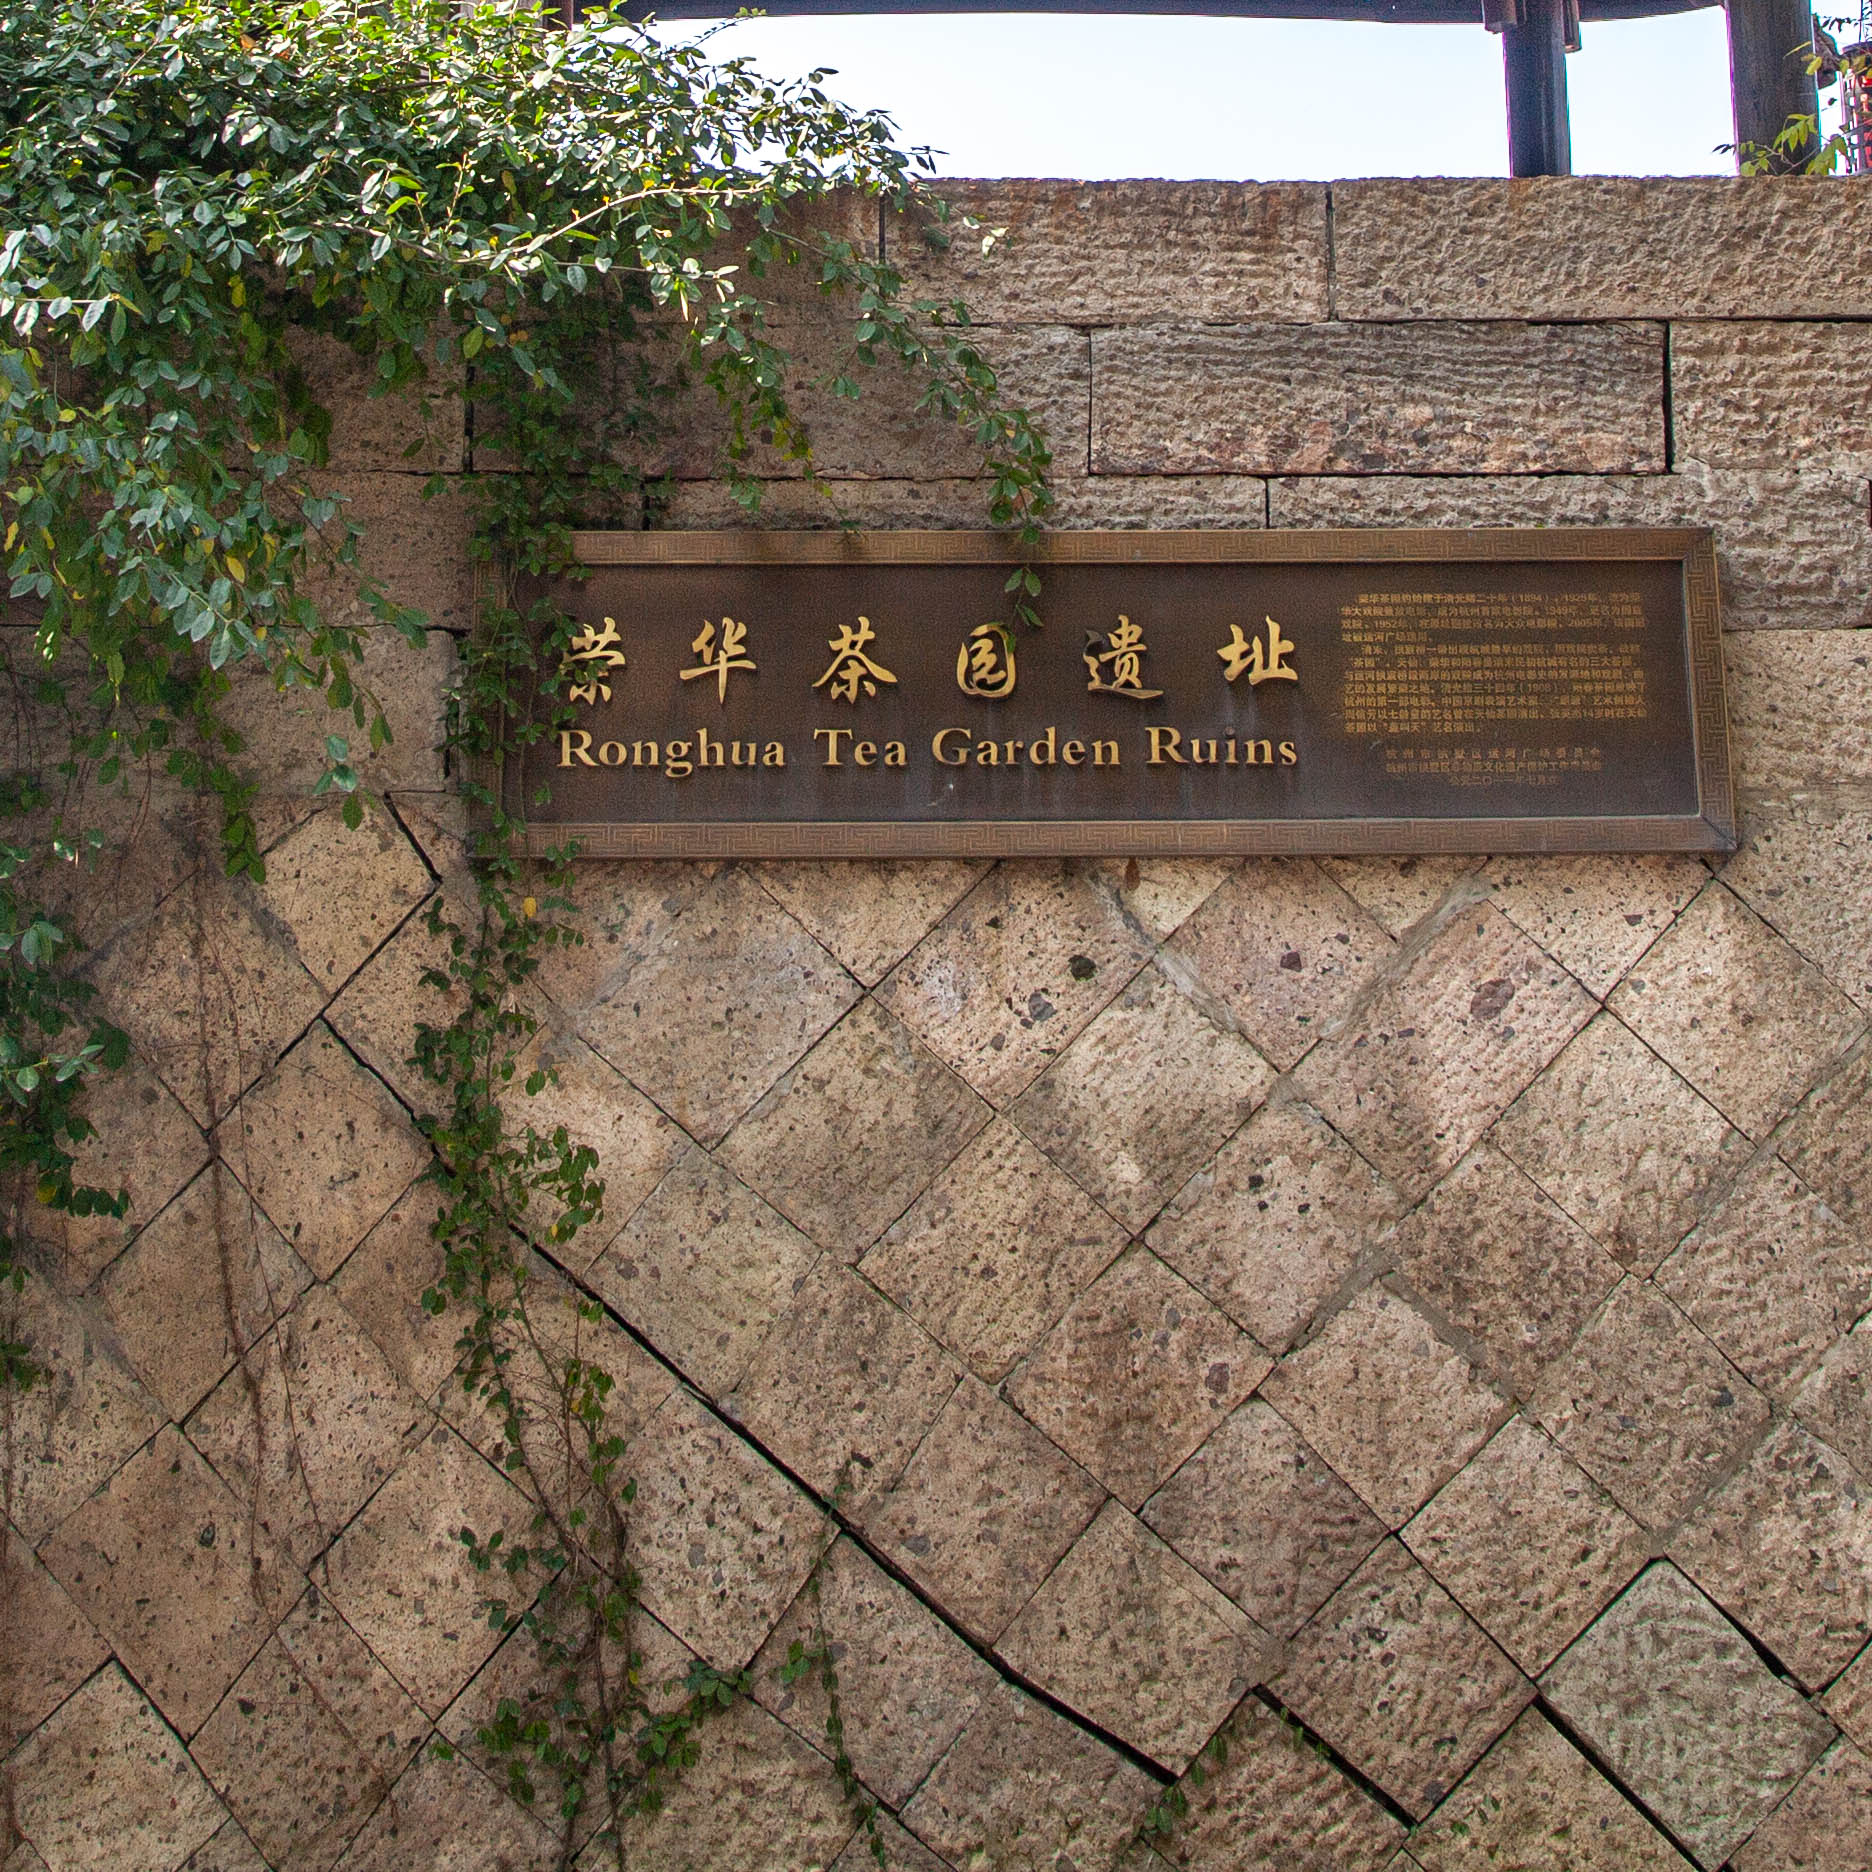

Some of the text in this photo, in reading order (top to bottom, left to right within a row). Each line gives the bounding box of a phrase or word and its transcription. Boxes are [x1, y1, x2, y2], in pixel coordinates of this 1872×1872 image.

[562, 614, 1298, 706] 荣华茶园遗址
[556, 725, 1298, 778] Ronghua Tea Garden Ruins
